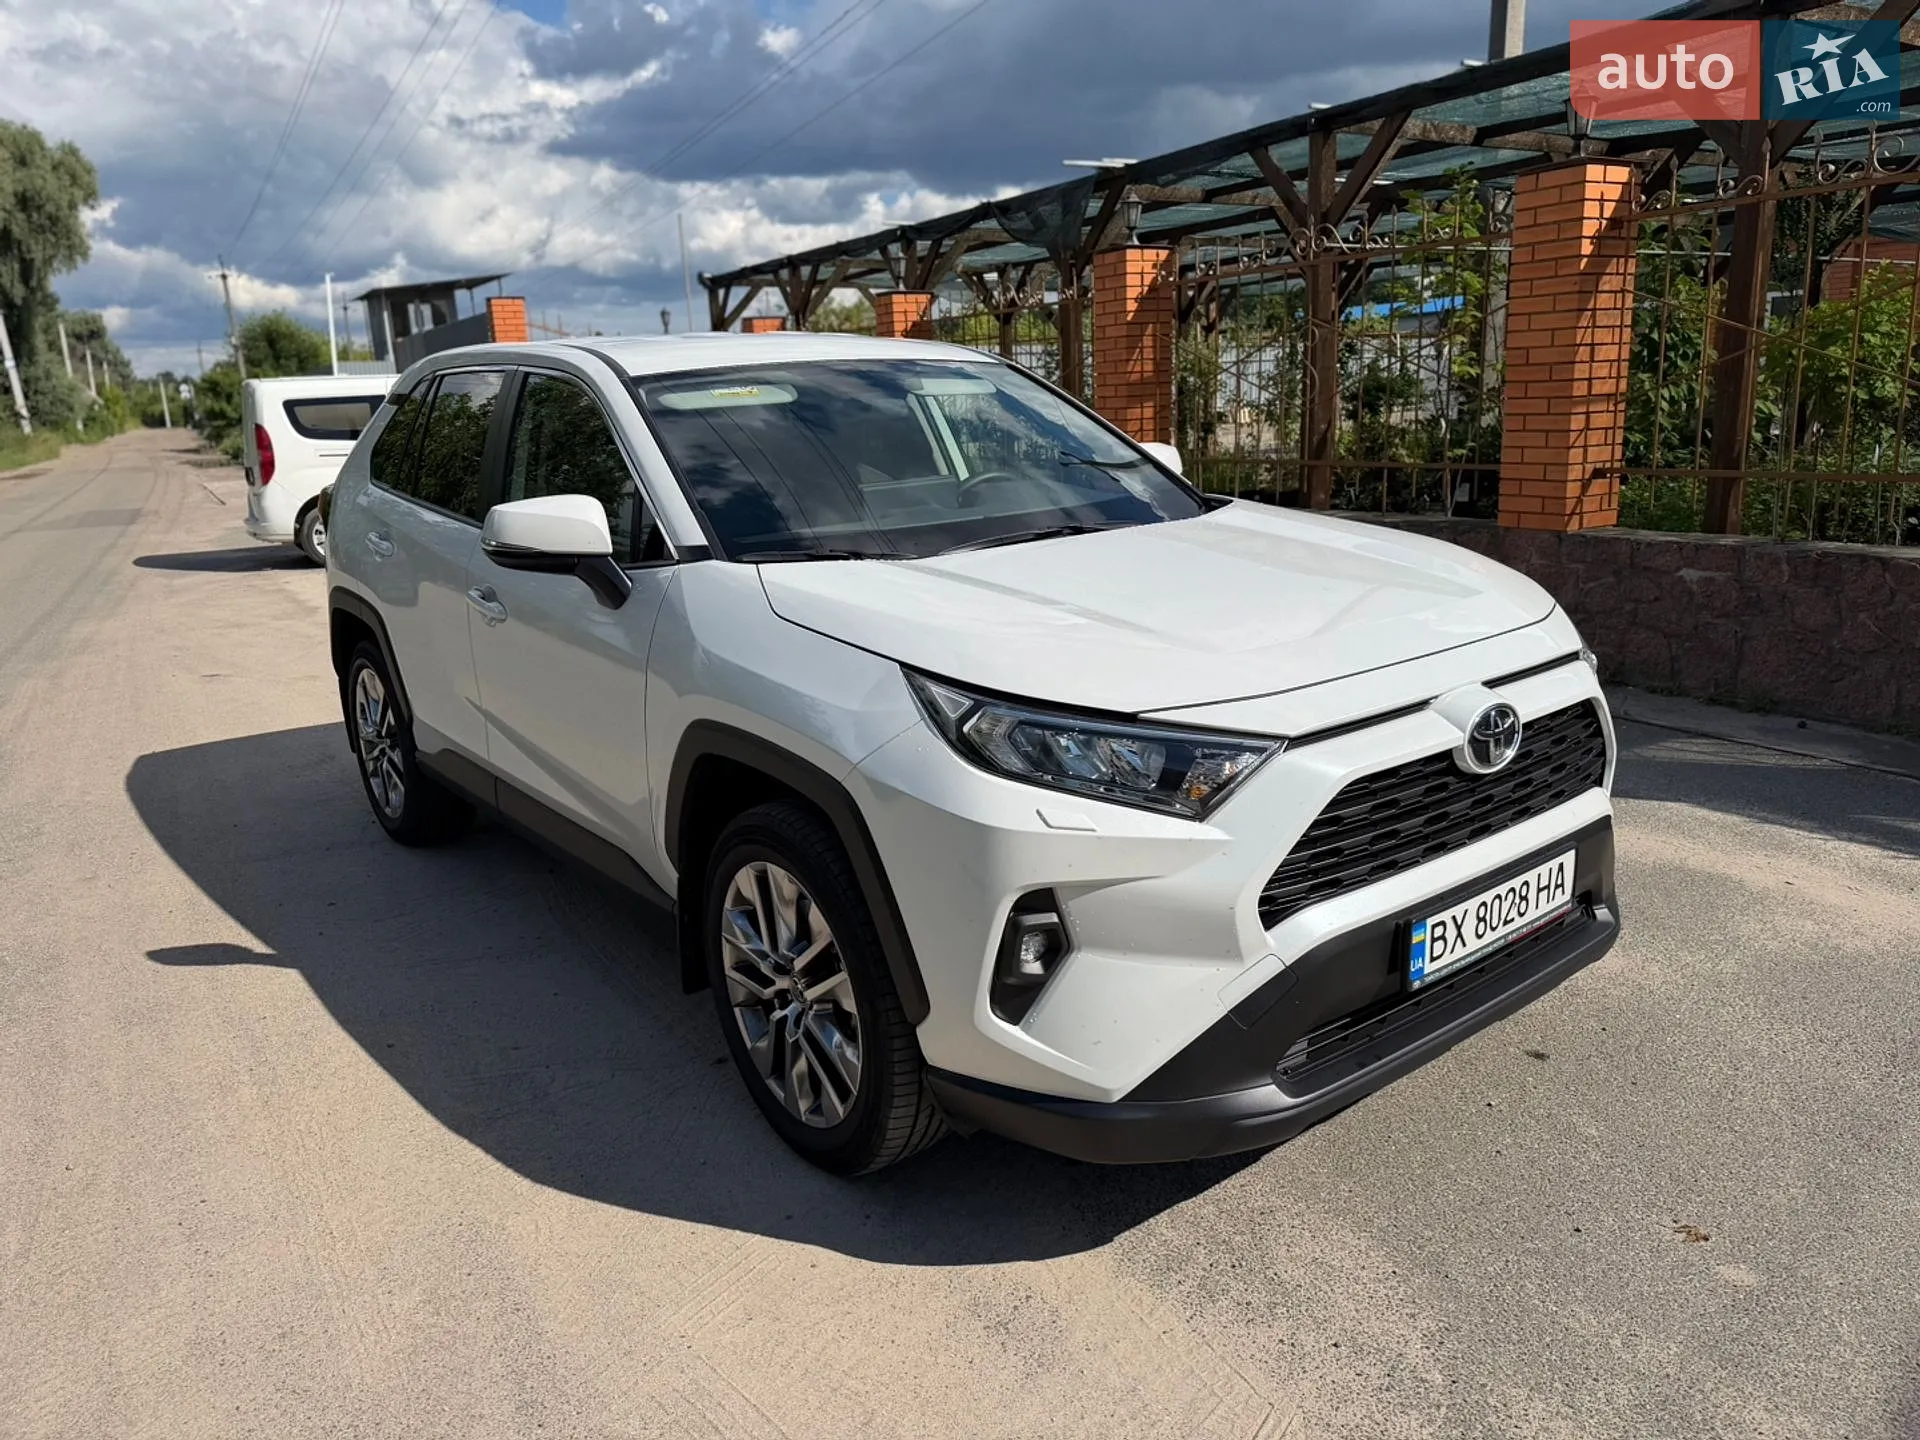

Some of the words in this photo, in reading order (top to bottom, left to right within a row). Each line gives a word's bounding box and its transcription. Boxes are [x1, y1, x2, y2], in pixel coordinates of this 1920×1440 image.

[1429, 908, 1468, 964] BX
[1474, 880, 1530, 940] 8028
[1535, 862, 1565, 910] HA
[1410, 957, 1424, 972] UA
